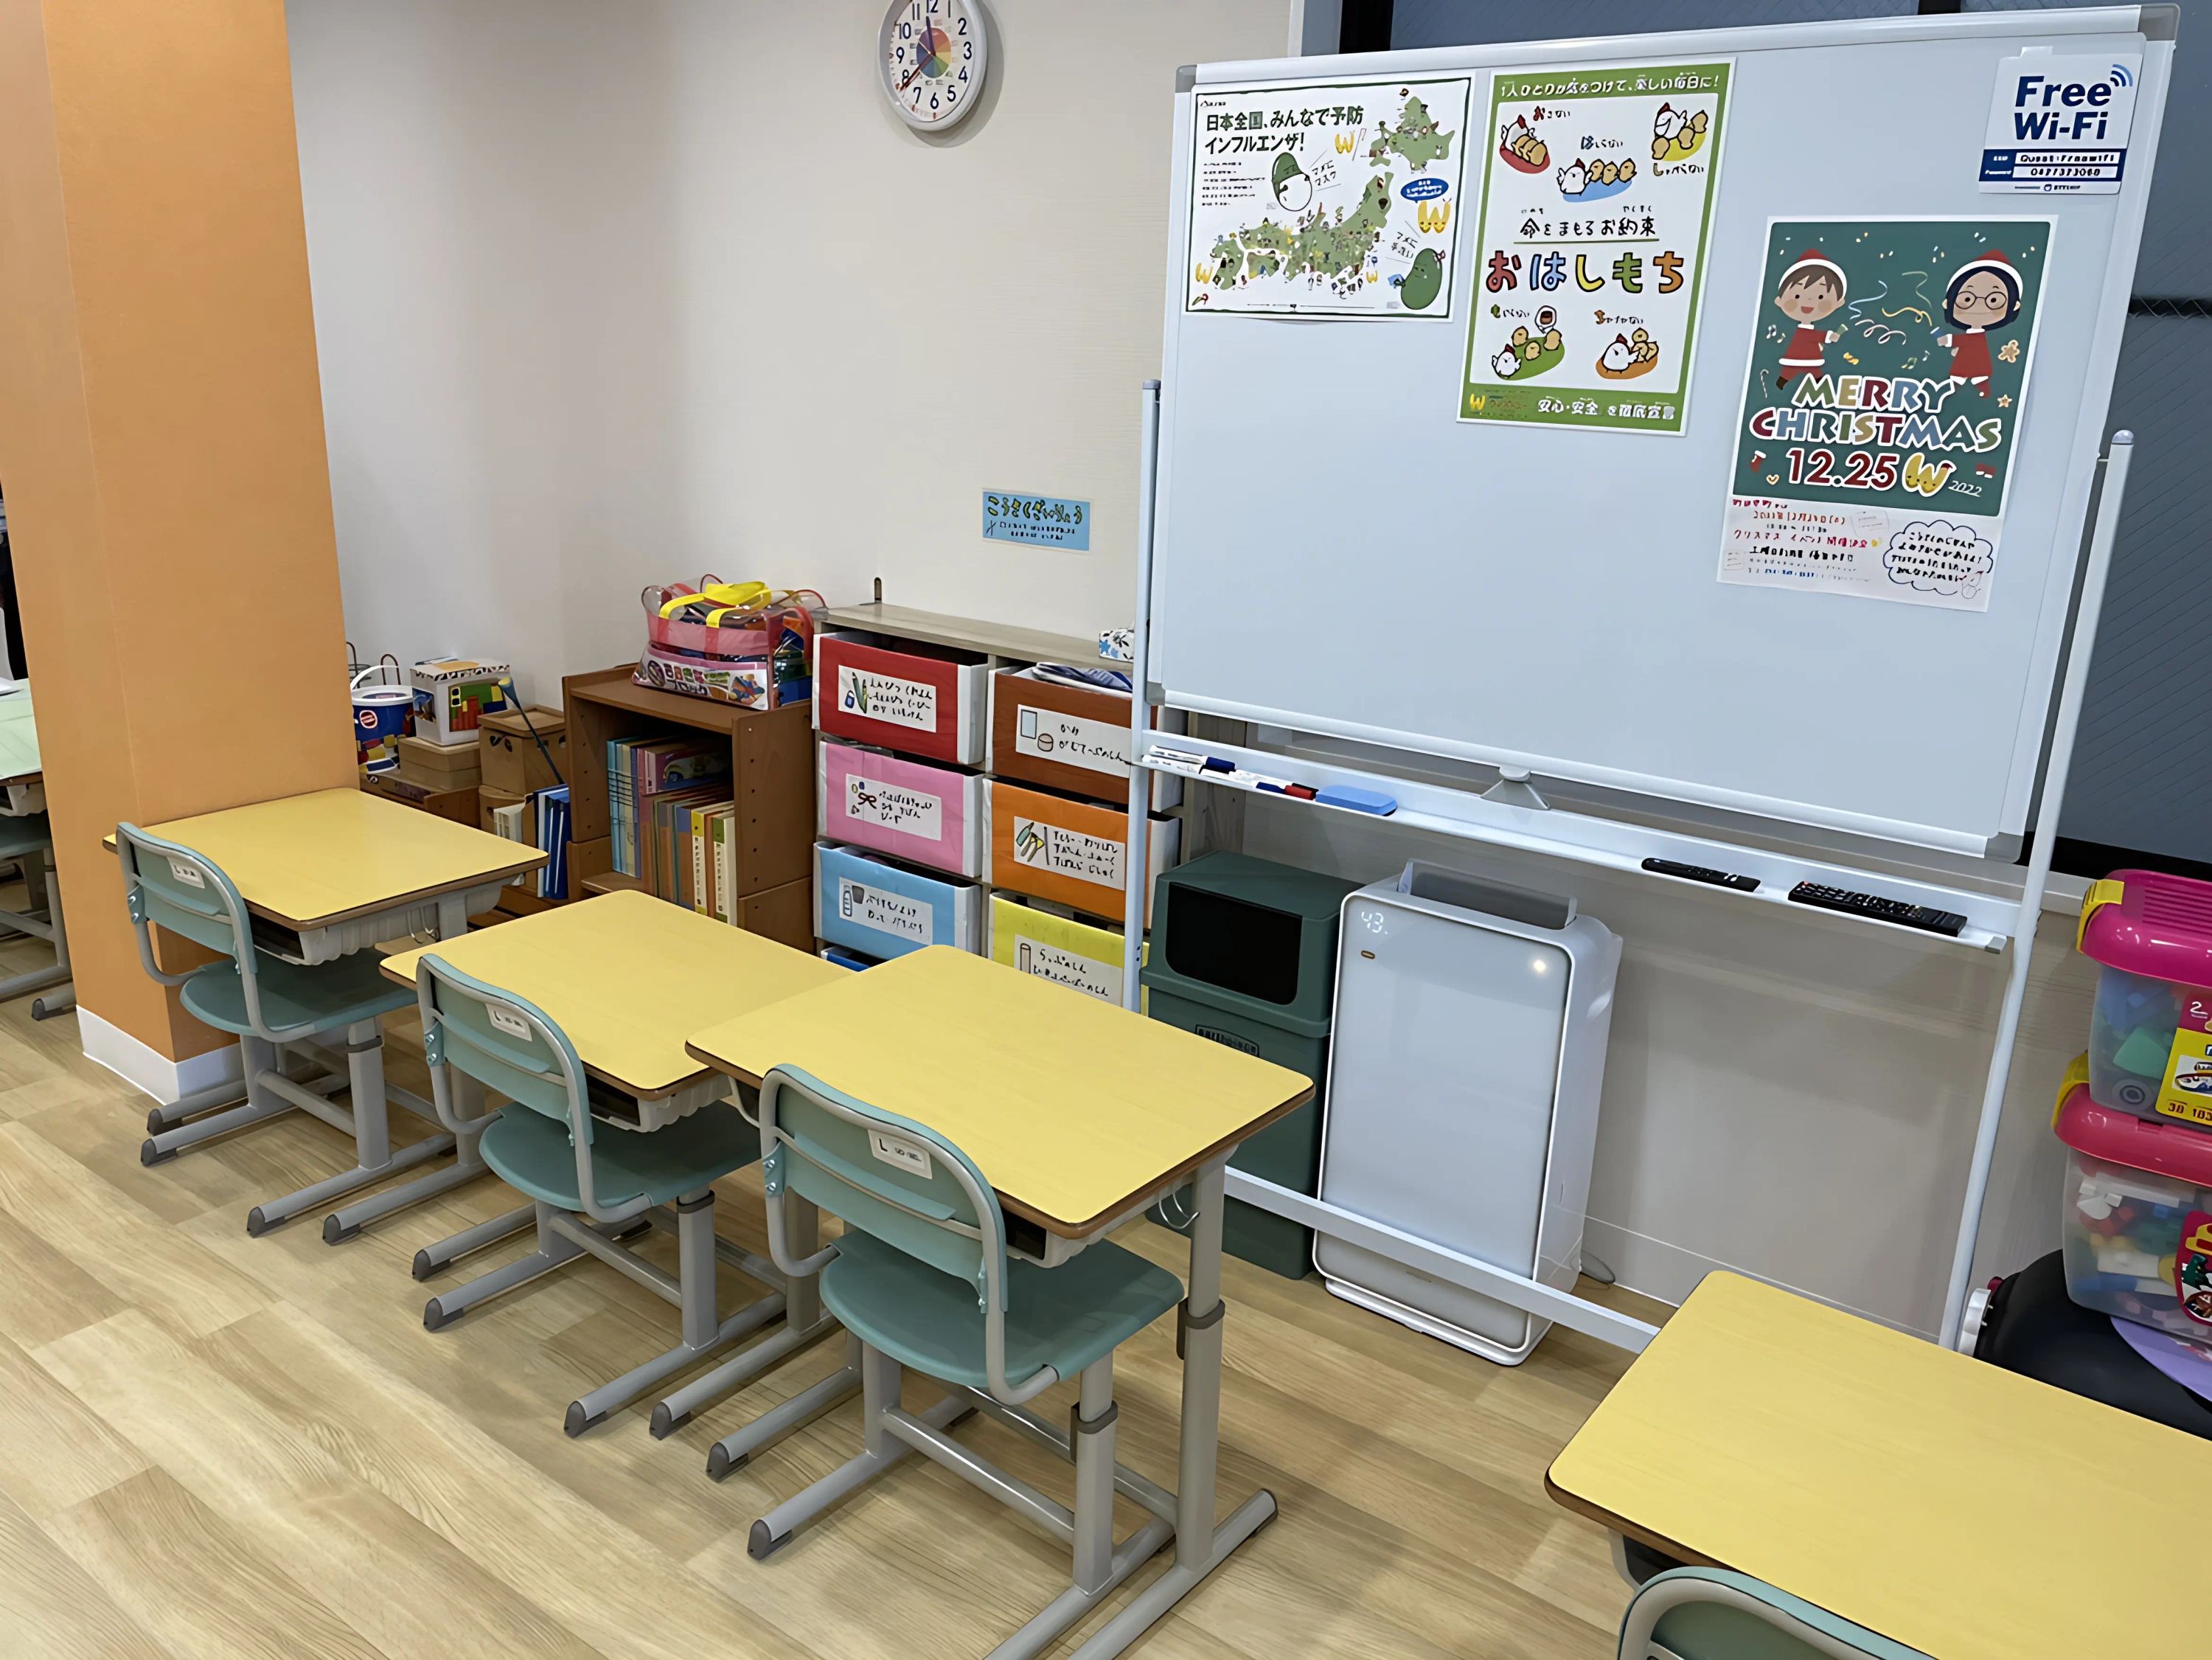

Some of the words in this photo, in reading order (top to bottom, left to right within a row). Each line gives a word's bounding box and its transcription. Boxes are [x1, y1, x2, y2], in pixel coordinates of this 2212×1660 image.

[912, 3, 921, 21] 11
[926, 0, 939, 13] 12
[898, 22, 911, 39] 10
[958, 18, 967, 35] 2
[896, 46, 905, 63] 9
[963, 41, 972, 60] 3
[958, 66, 967, 83] 4
[913, 87, 922, 104] 7
[930, 92, 939, 109] 6
[947, 85, 956, 102] 5
[2015, 76, 2112, 107] Free
[2014, 111, 2108, 139] Wi-Fi
[1486, 250, 1685, 294] おはしもち
[1792, 373, 1955, 413] MERRY
[1750, 407, 2001, 453] CHRISTMAS
[1786, 447, 1901, 492] 12.25
[1947, 480, 1983, 497] 2022
[1361, 911, 1384, 934] 43
